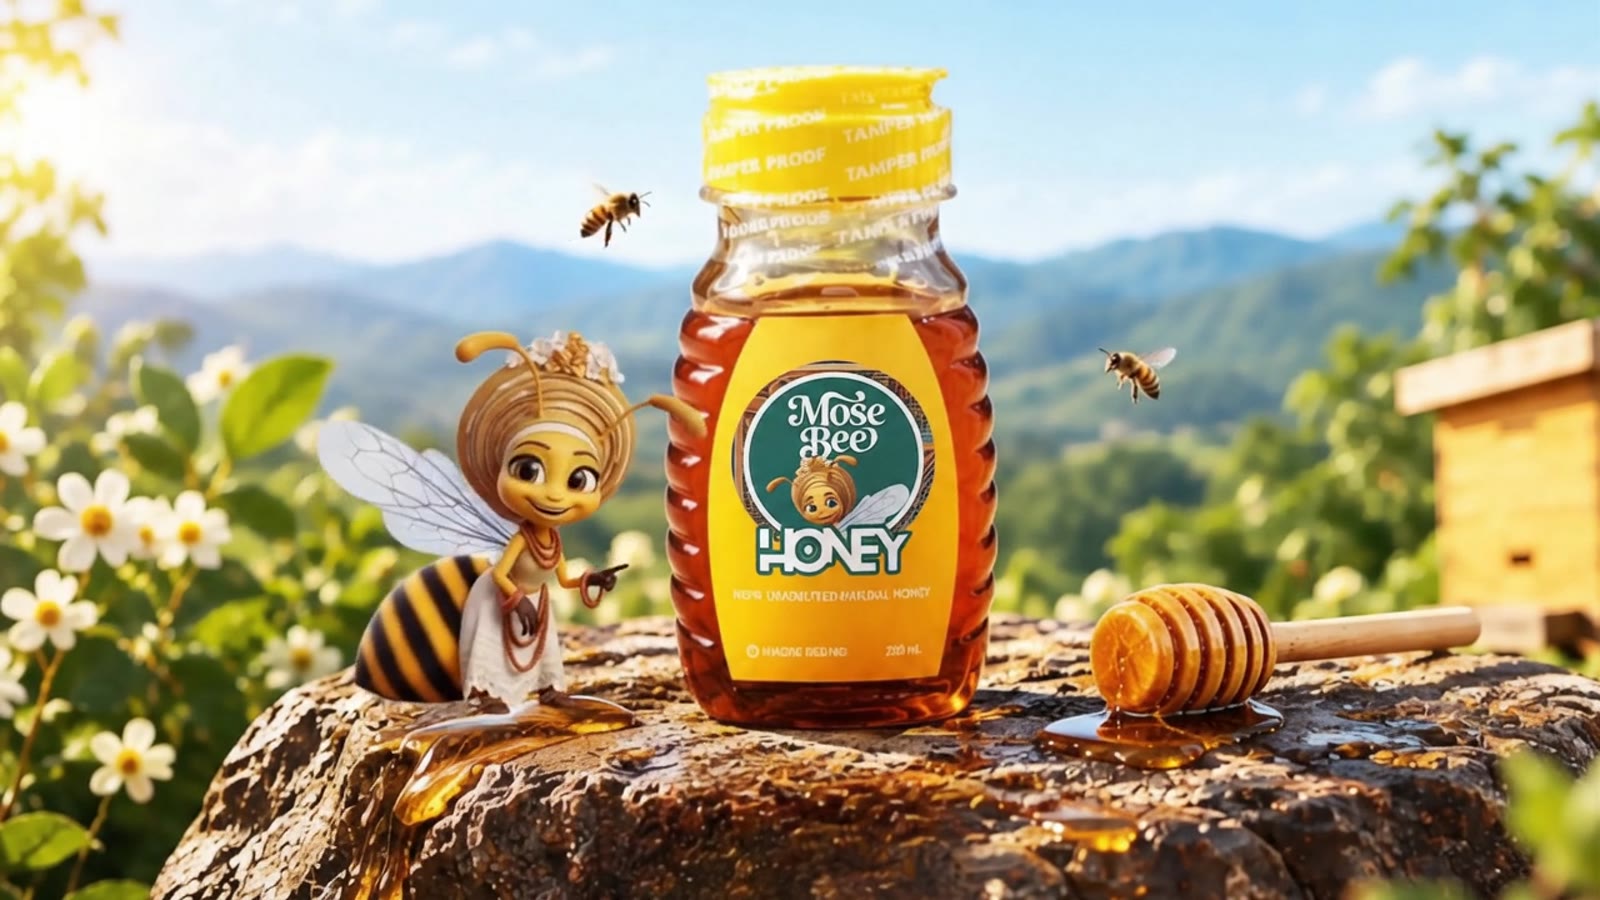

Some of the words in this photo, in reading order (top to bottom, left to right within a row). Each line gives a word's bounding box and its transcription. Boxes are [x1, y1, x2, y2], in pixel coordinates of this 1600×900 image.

[844, 114, 916, 143] TAMPER
[765, 147, 826, 171] PROOF
[846, 152, 918, 182] TAMPER
[788, 391, 886, 426] Mose
[799, 426, 878, 459] Bee
[758, 526, 910, 574] HONEY
